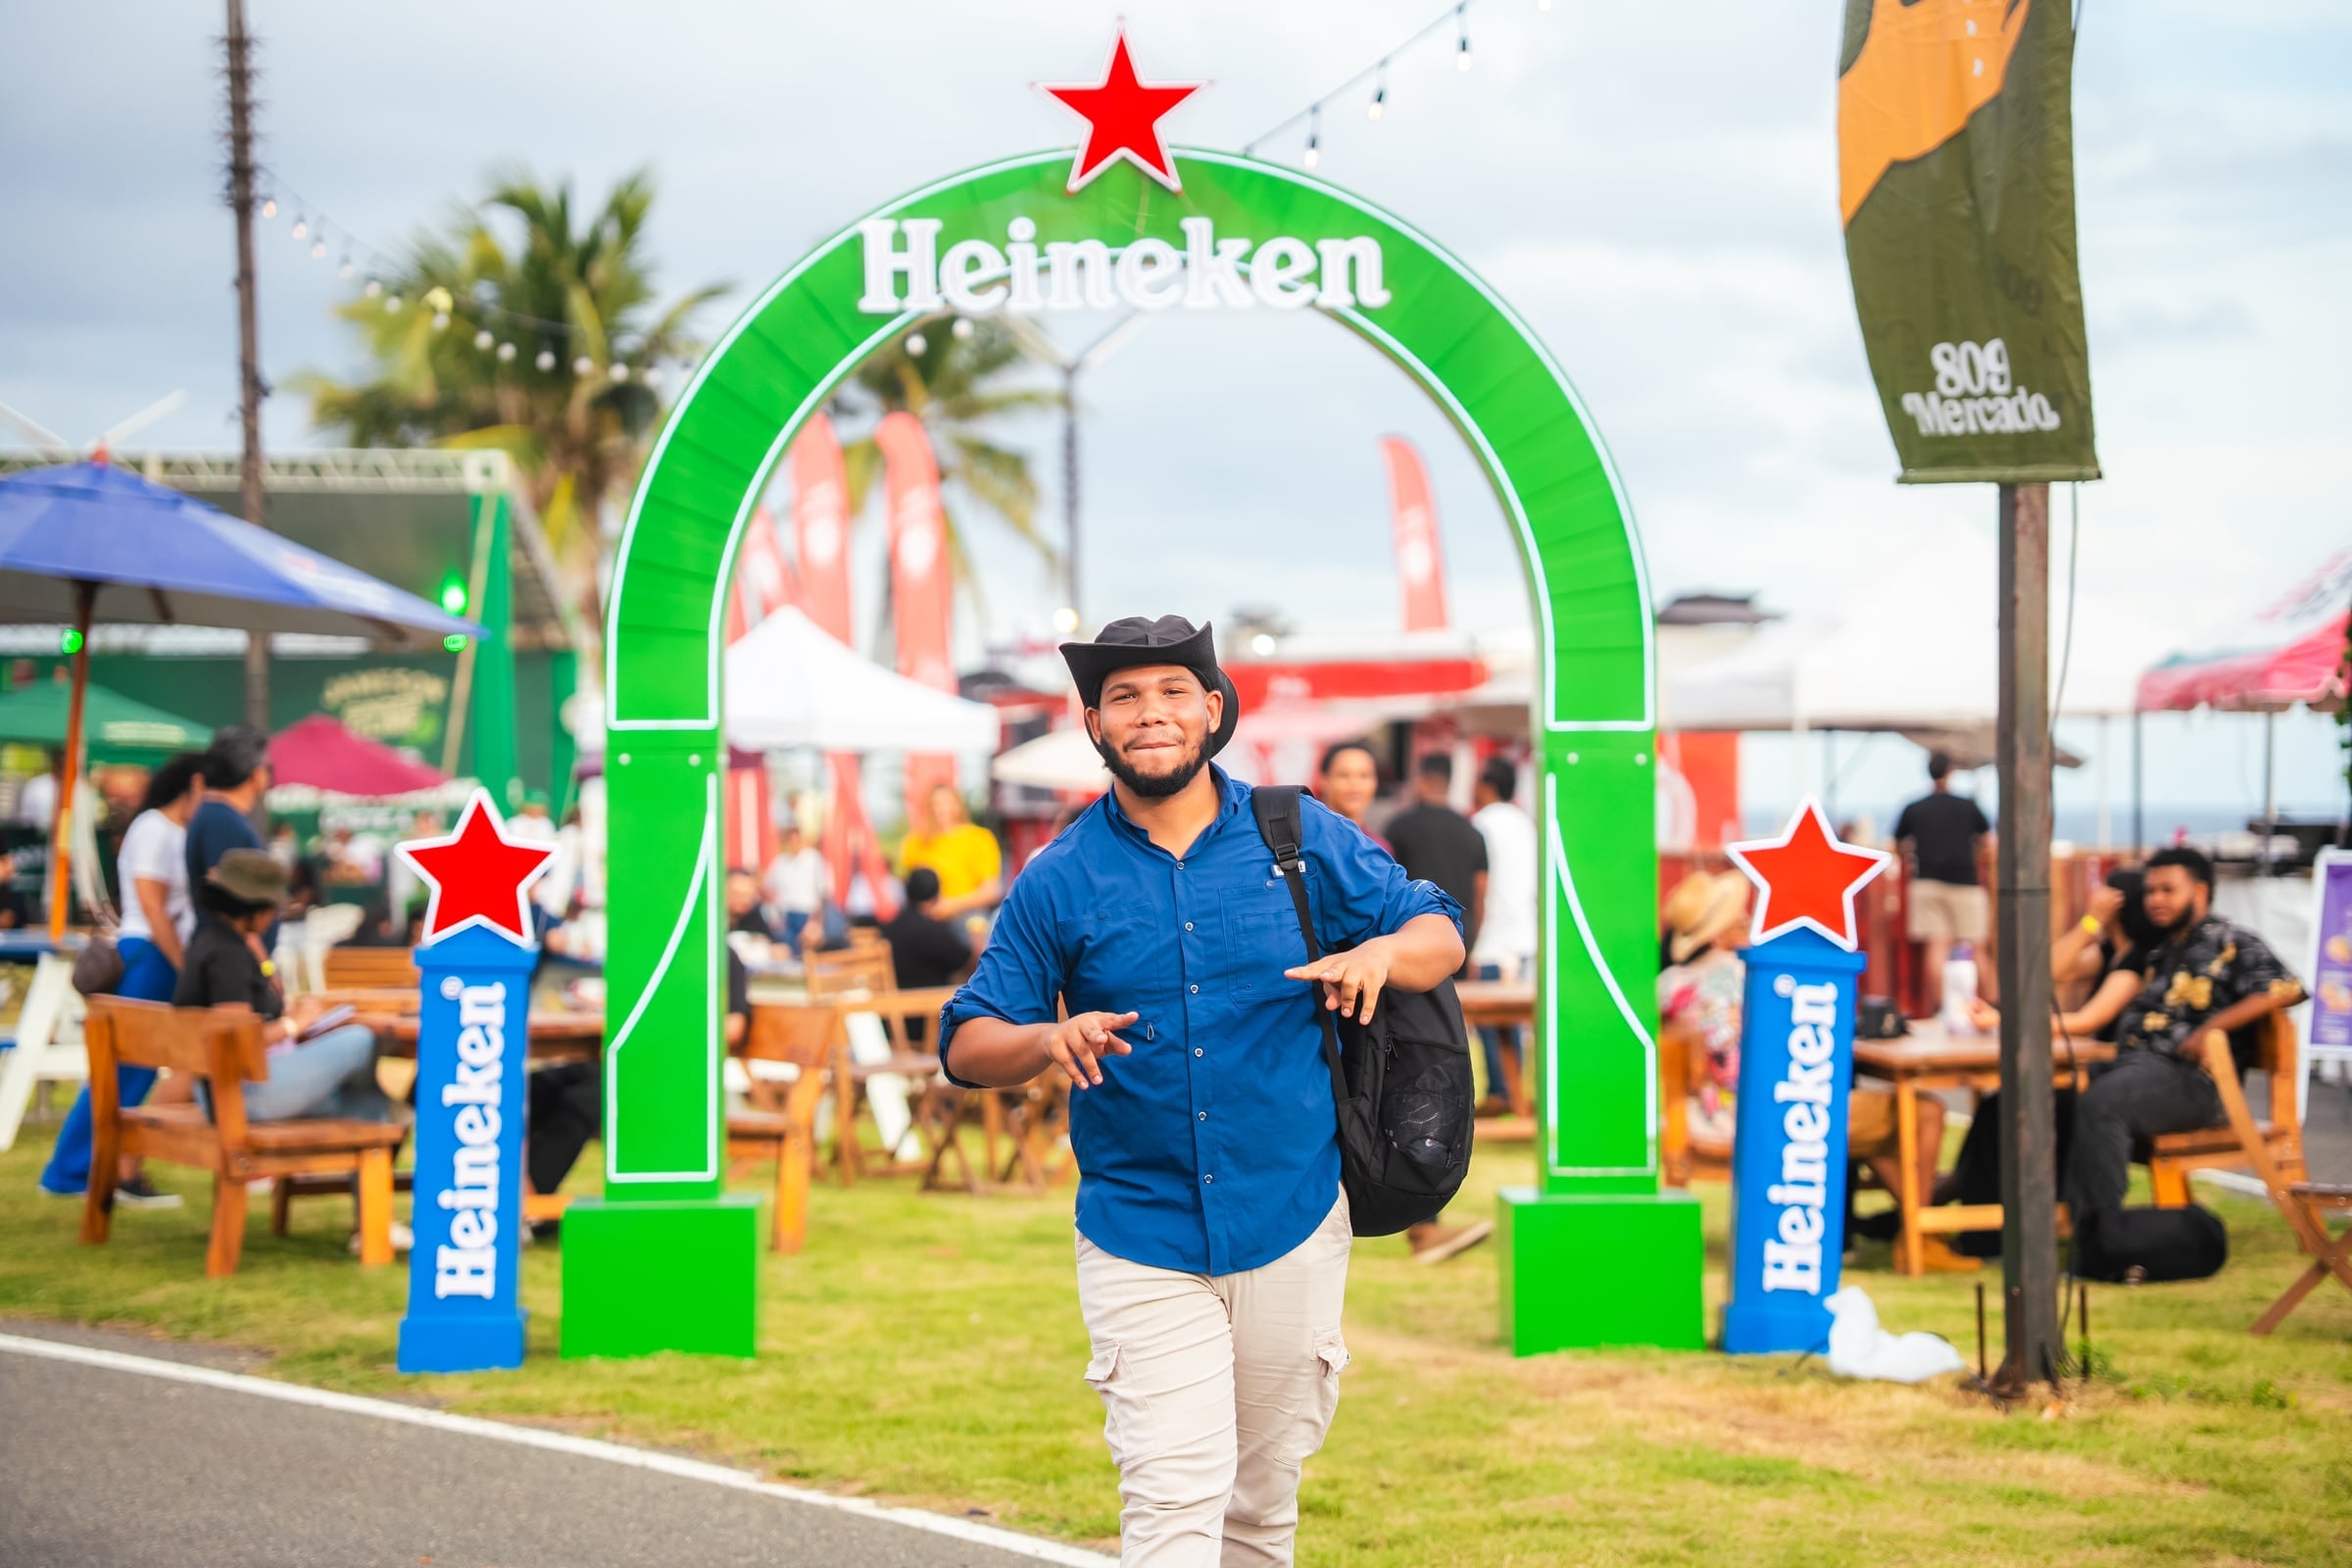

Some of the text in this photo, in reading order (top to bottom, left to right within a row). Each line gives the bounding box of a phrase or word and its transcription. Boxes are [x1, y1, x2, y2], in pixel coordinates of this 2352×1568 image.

[857, 217, 1392, 313] Heineken
[1901, 385, 2061, 437] Mercado
[1931, 338, 2012, 397] 809
[435, 981, 507, 1299] Heineken
[1762, 982, 1838, 1295] Heineken
